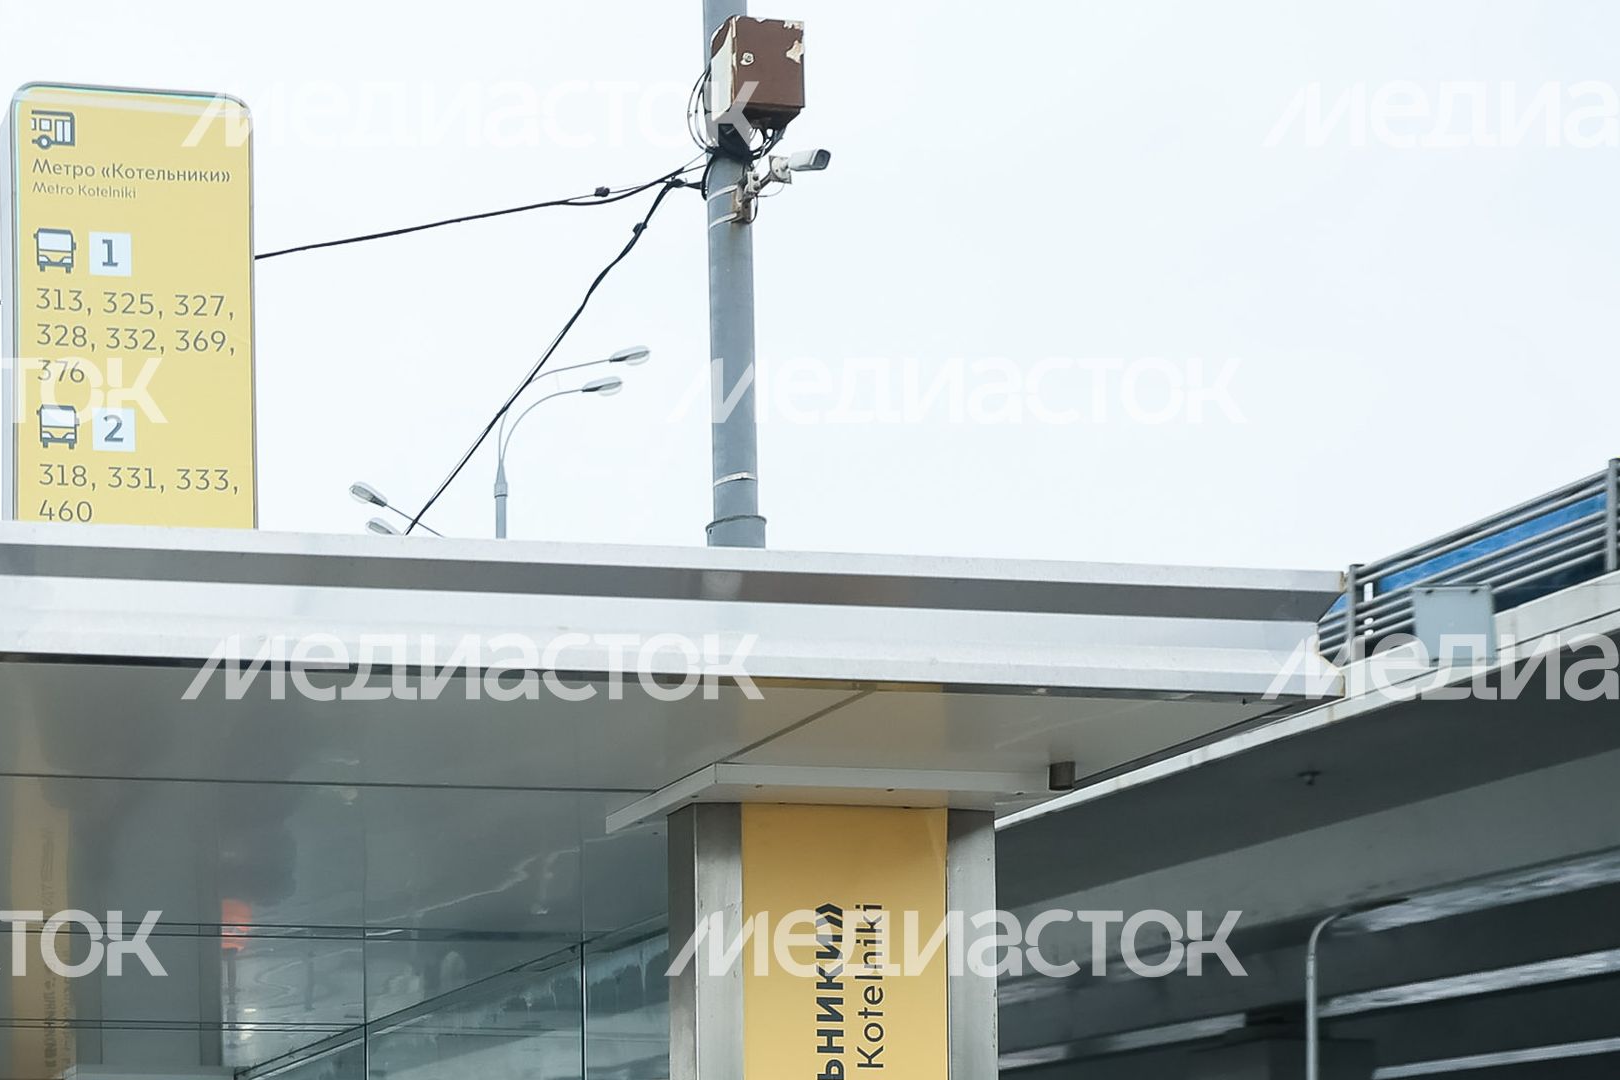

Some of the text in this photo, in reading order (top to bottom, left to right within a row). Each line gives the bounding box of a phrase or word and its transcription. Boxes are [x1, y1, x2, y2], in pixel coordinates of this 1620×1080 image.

[32, 158, 231, 183] Метро «Котельники»
[32, 181, 136, 199] Metro Kotelniki
[101, 239, 119, 268] 1
[35, 287, 235, 320] 313, 325, 327,
[36, 323, 236, 356] 328, 332, 369,
[37, 359, 85, 383] 376
[103, 414, 124, 443] 2
[39, 463, 239, 494] 318, 331, 333,
[39, 501, 93, 523] 460
[856, 903, 884, 1068] Kotelniki
